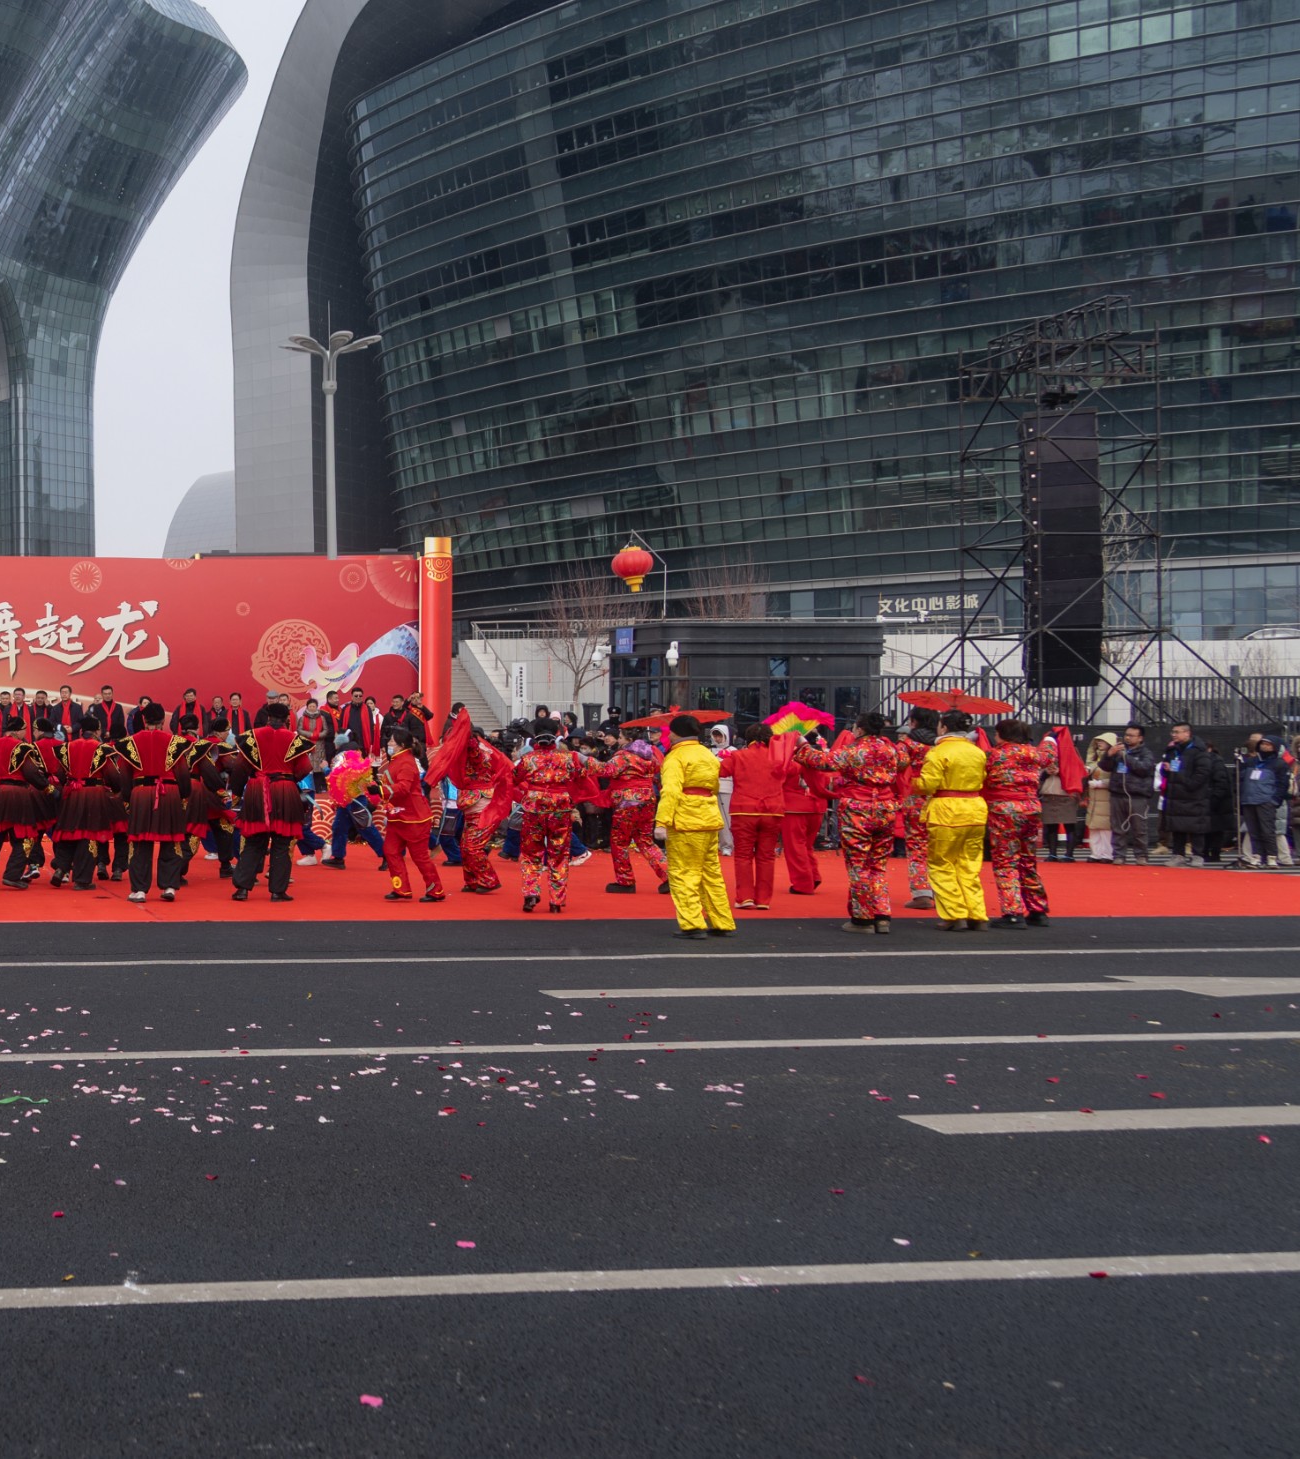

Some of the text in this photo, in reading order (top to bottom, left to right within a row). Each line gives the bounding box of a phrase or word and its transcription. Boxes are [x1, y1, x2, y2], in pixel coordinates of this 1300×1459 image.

[878, 593, 979, 614] 文化中心影城
